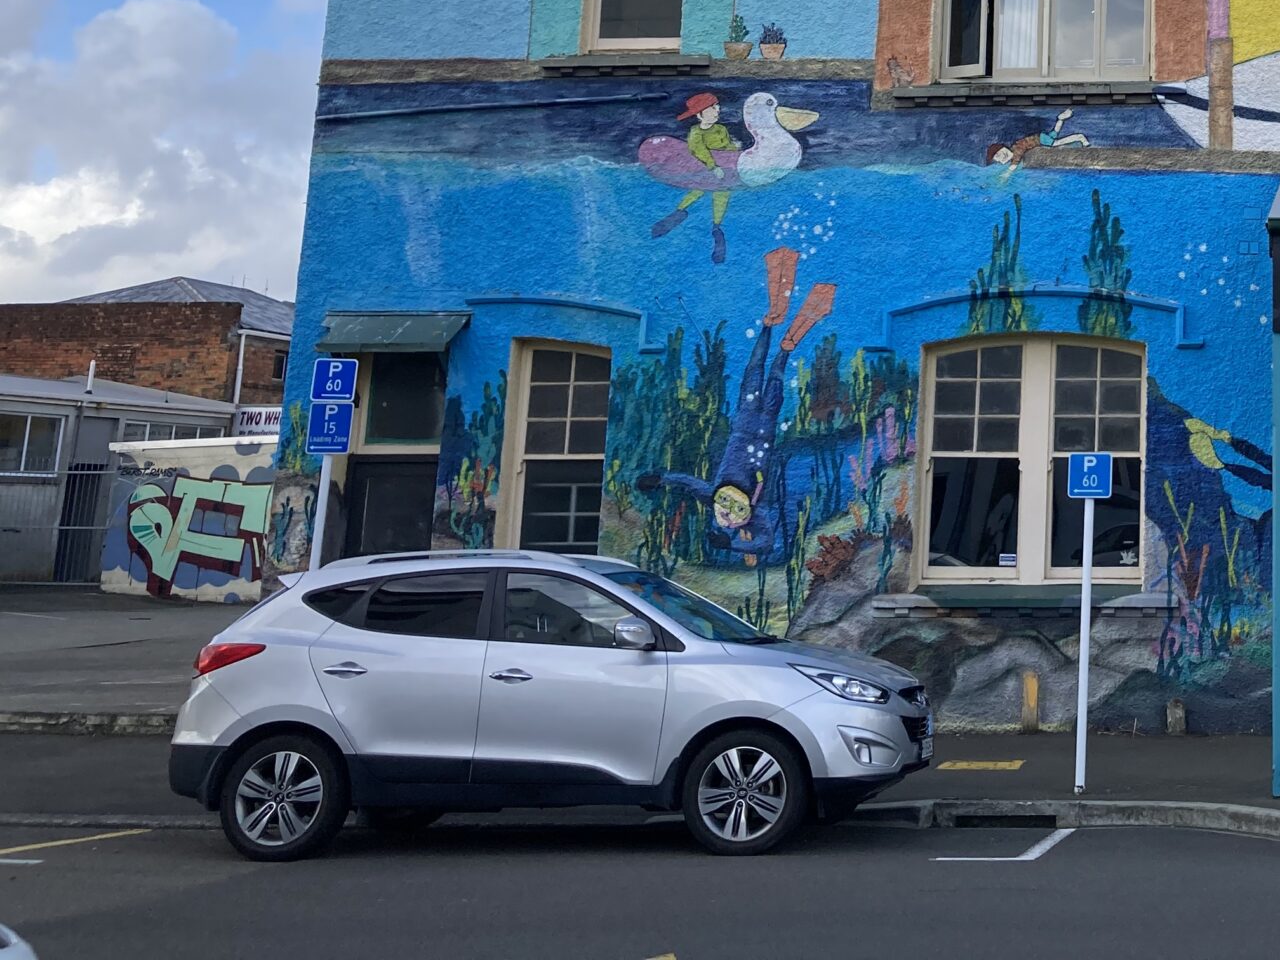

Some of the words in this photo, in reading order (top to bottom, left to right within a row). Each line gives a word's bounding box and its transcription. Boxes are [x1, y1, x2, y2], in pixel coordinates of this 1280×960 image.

[329, 362, 342, 377] P
[326, 379, 342, 391] 60
[240, 411, 262, 425] TWO
[325, 405, 338, 420] P
[324, 422, 336, 434] 15
[1084, 456, 1097, 472] P
[1083, 475, 1098, 487] 60
